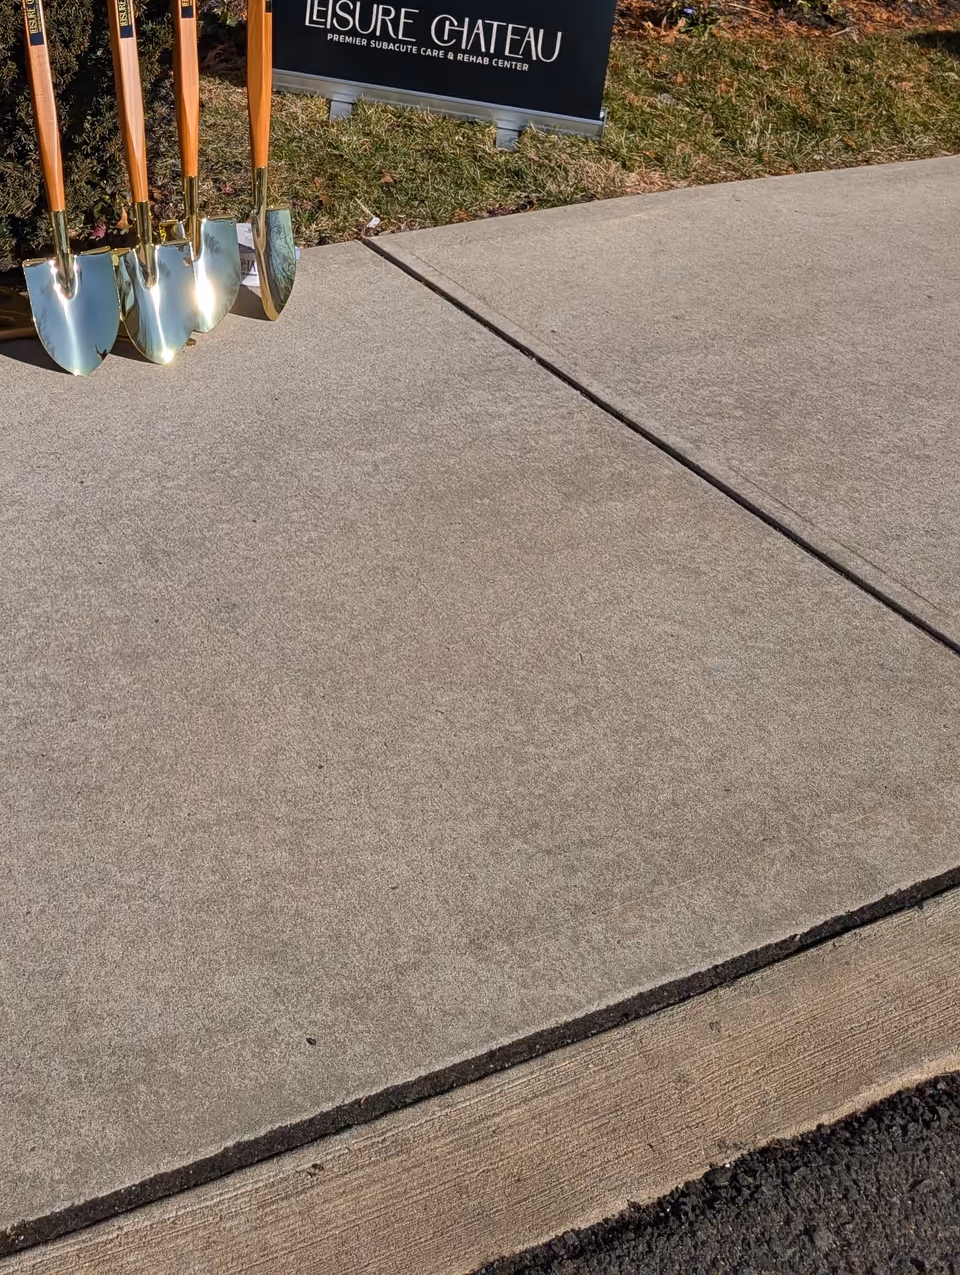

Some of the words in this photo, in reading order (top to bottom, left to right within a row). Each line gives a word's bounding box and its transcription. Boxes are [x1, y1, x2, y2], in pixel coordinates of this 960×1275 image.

[327, 33, 367, 47] PREMIER
[370, 39, 418, 54] SUBACUTE
[420, 47, 445, 58] CARE
[447, 51, 454, 60] &
[457, 53, 490, 65] REHAB
[492, 58, 529, 71] CENTER
[430, 14, 562, 63] CHATEAU
